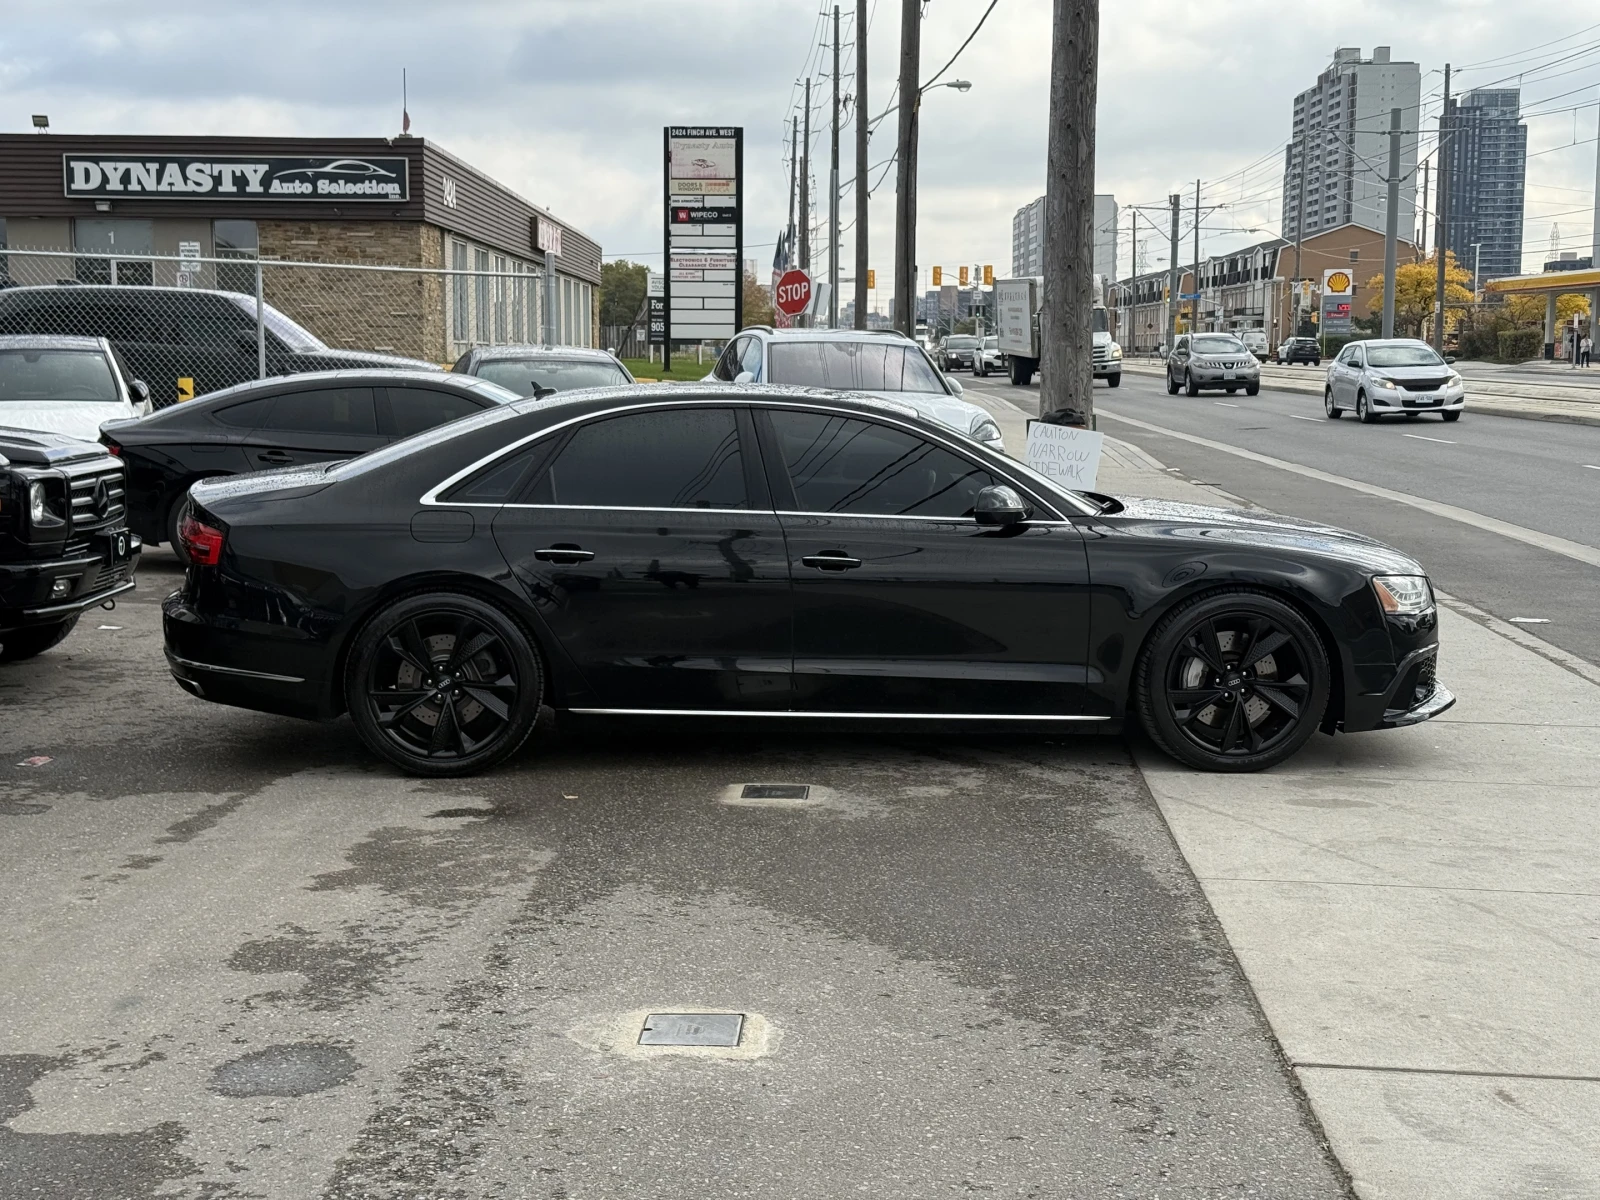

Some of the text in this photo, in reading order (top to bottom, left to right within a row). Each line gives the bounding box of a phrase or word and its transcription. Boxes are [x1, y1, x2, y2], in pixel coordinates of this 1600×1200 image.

[70, 161, 269, 193] DYNASTY
[268, 179, 401, 194] Auto Selection
[108, 231, 114, 244] 1
[778, 282, 809, 304] STOP
[651, 300, 664, 310] For
[651, 322, 664, 332] 905
